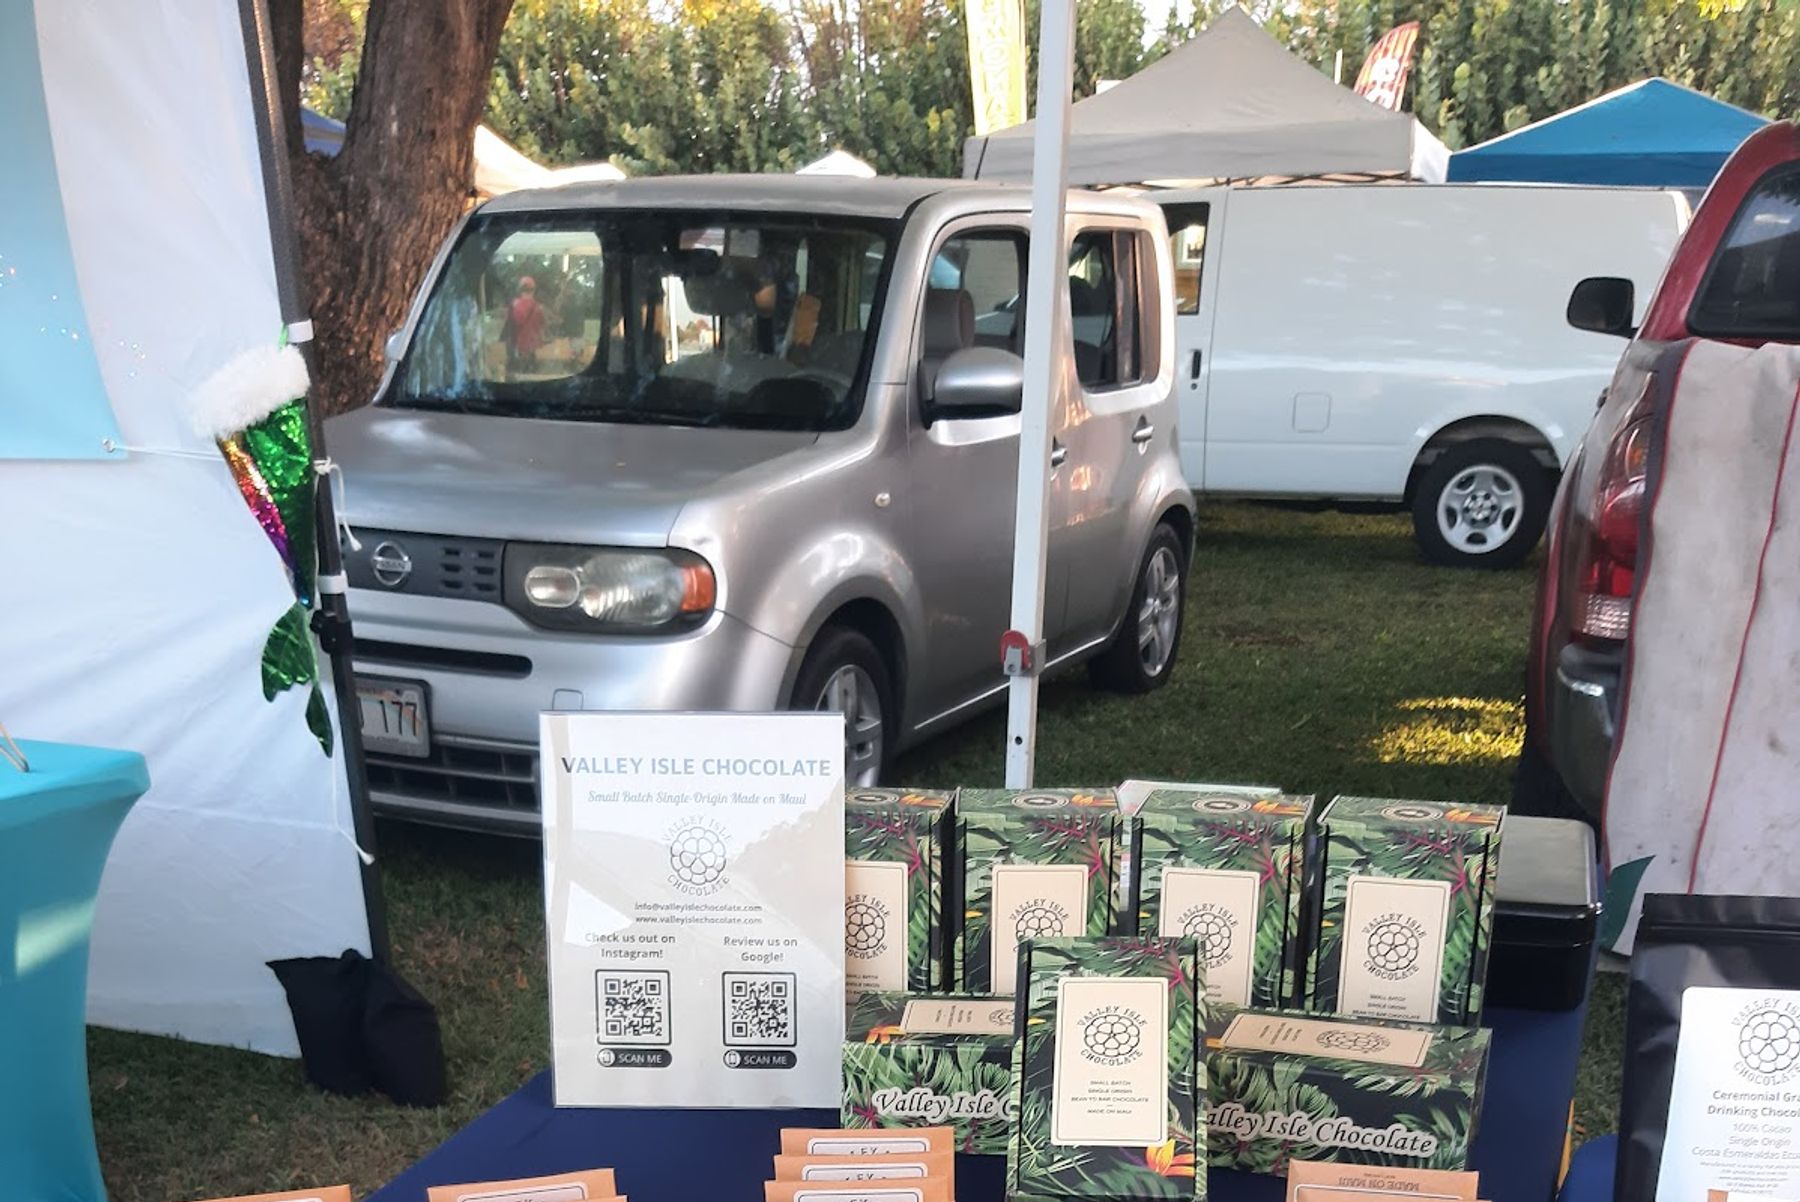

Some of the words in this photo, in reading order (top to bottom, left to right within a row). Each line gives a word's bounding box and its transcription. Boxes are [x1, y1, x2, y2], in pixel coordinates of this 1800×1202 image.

[561, 757, 643, 775] VALLEY
[652, 758, 695, 775] ISLE
[702, 759, 831, 776] CHOCOLATE
[588, 790, 620, 803] Small
[622, 790, 654, 803] Batch
[731, 792, 760, 804] Made
[778, 793, 807, 805] Maui
[667, 874, 731, 896] CHOCOLATE
[584, 932, 619, 944] Check
[622, 935, 635, 944] us
[638, 934, 658, 944] out
[661, 936, 676, 944] on
[724, 936, 765, 947] Review
[767, 938, 780, 947] us
[783, 939, 798, 947] on
[601, 948, 663, 960] Instagram!
[741, 951, 784, 964] Google!
[618, 1054, 644, 1064] SCAN
[647, 1054, 662, 1064] ME
[744, 1055, 770, 1065] SCAN
[773, 1055, 787, 1065] ME
[1080, 1048, 1143, 1066] CHOCOLATE
[1712, 1090, 1780, 1101] Ceremonial
[876, 1092, 947, 1119] Valley
[954, 1094, 993, 1113] Isle
[1707, 1105, 1758, 1119] Drinking
[1206, 1108, 1257, 1135] alley
[1265, 1115, 1307, 1136] Isle
[1316, 1120, 1432, 1153] Chocolate
[1728, 1136, 1759, 1147] Single
[1761, 1137, 1792, 1149] Origin
[1692, 1146, 1721, 1157] Costa
